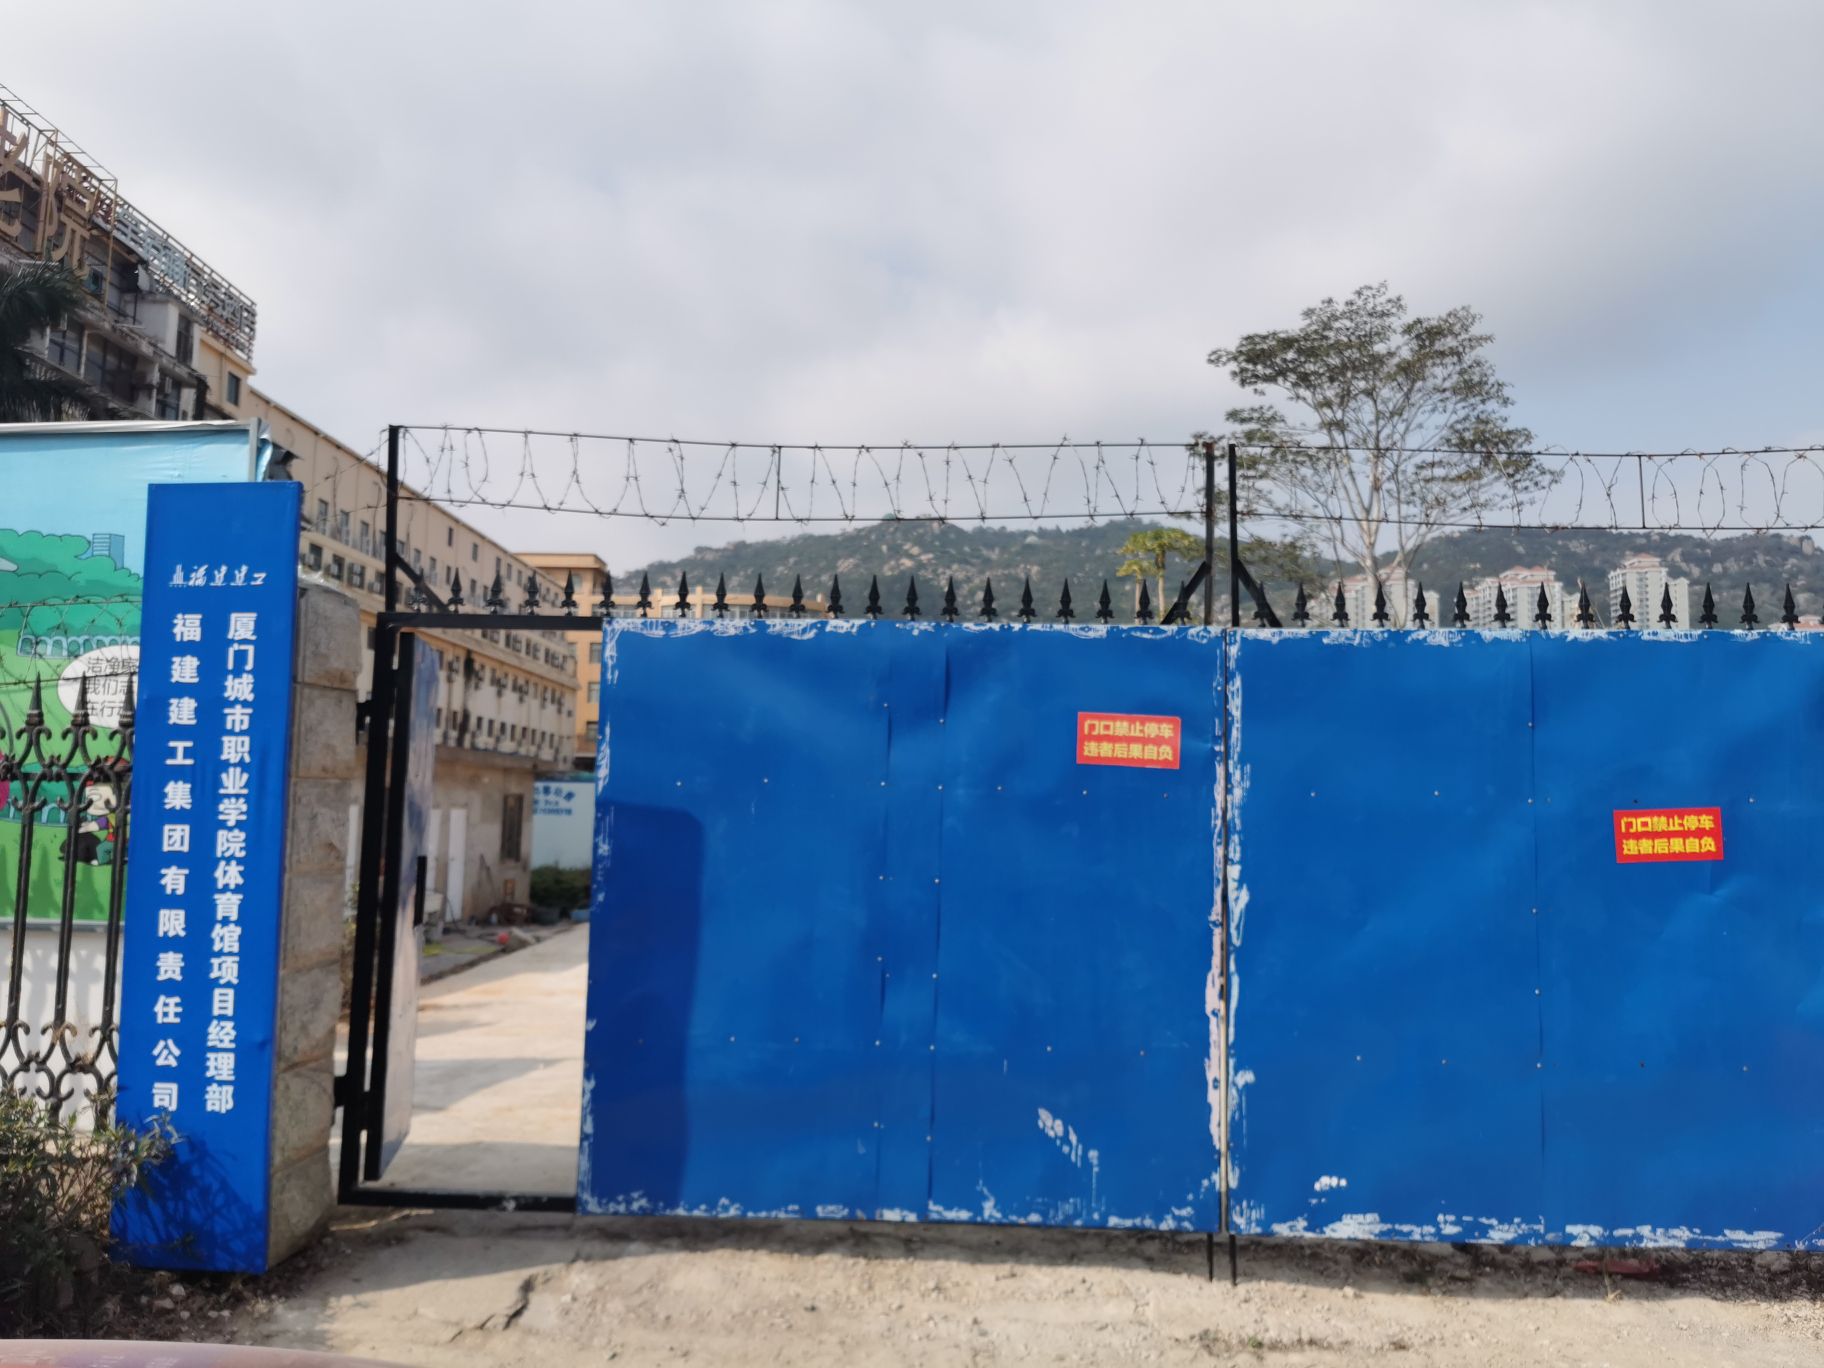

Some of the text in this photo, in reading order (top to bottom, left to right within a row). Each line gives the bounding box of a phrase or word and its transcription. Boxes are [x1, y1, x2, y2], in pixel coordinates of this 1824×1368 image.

[86, 700, 134, 718] 在行
[1084, 719, 1174, 739] 门口禁止停车
[1083, 741, 1173, 761] 违者后果自负
[1621, 814, 1715, 833] 门口禁止停车
[1622, 836, 1716, 855] 违者后果自负
[151, 612, 203, 1112] 福建建工集团有限责任公司
[204, 612, 258, 1114] 厦门城市职业学院体育馆项目经理部
